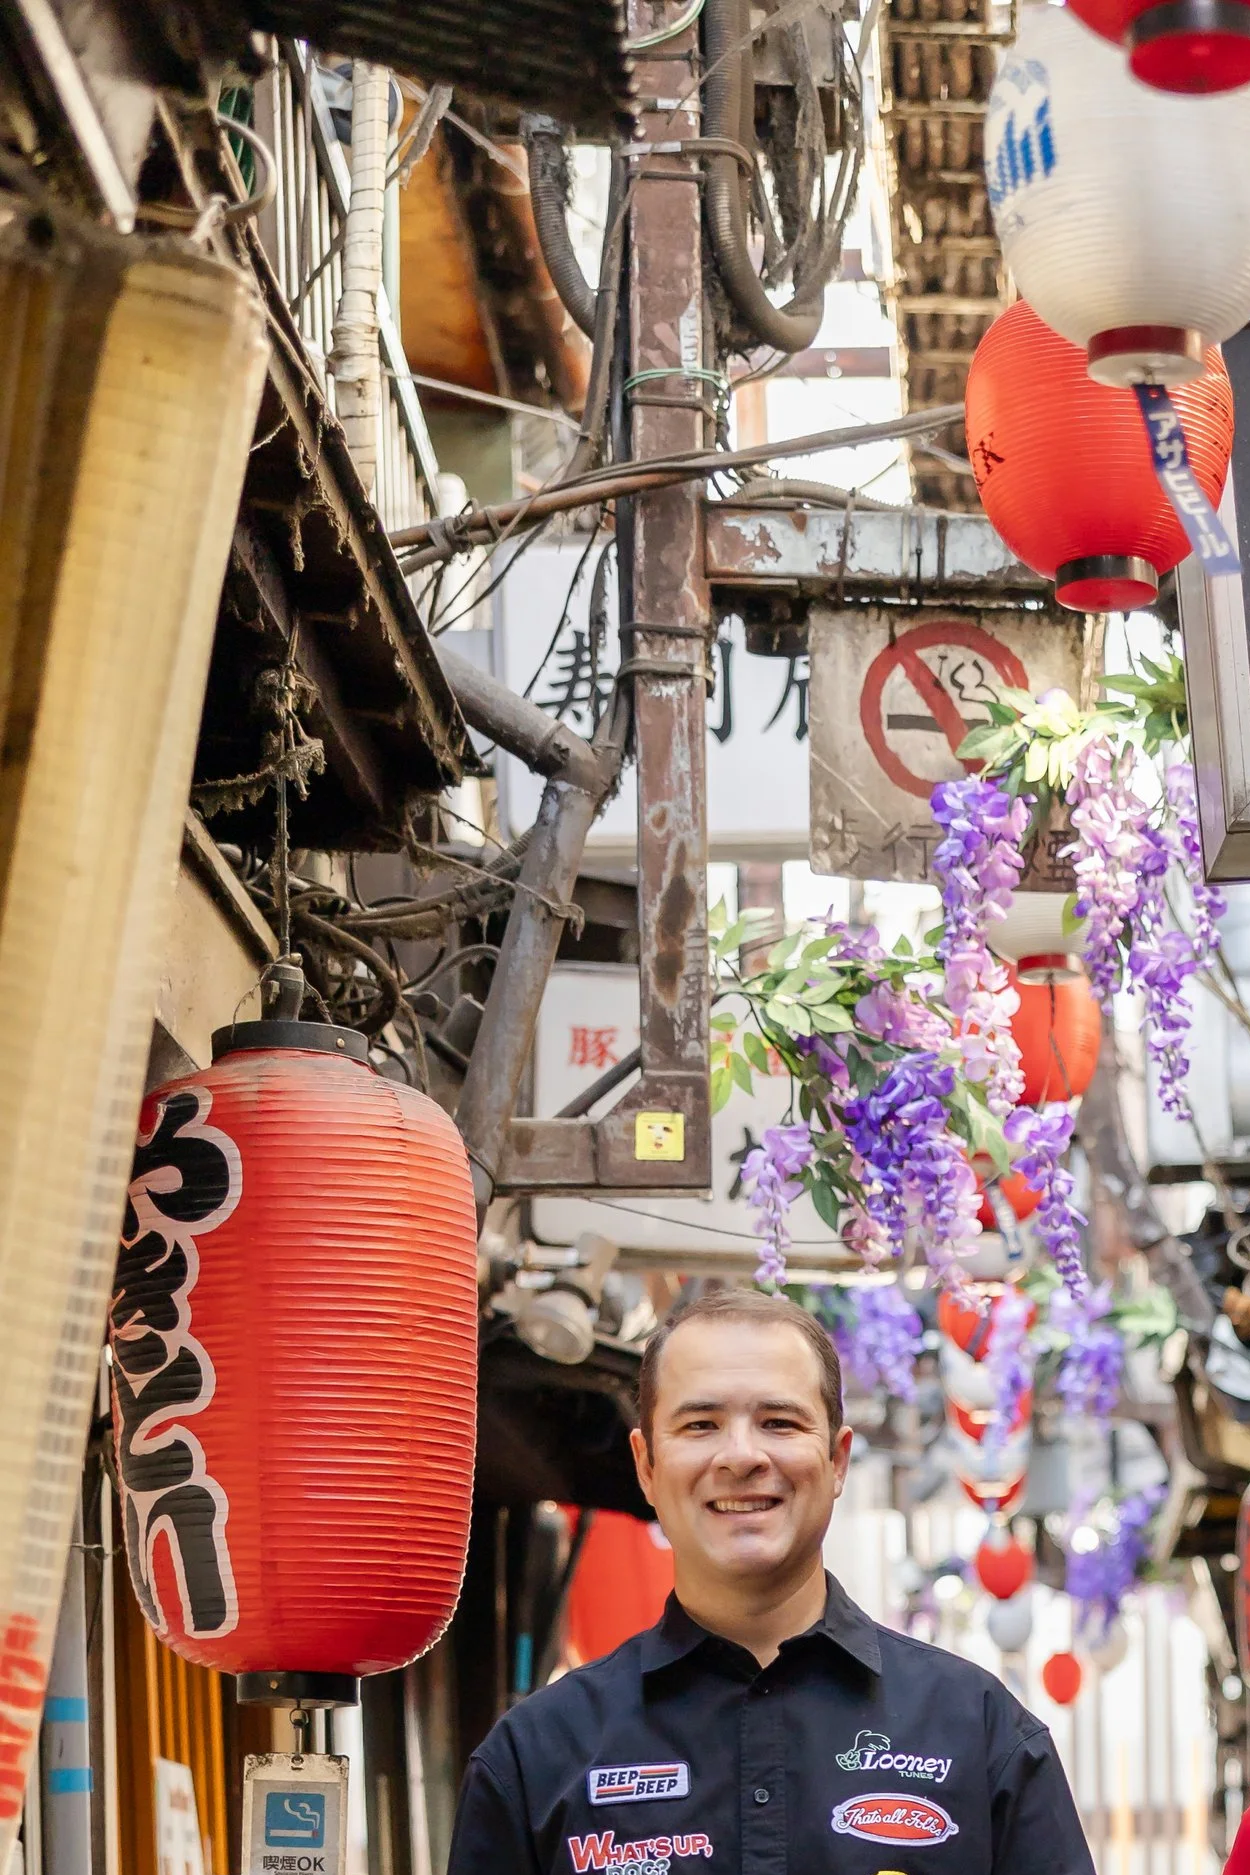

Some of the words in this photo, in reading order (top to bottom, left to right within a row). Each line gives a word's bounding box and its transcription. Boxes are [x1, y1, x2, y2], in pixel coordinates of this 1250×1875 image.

[1148, 411, 1231, 560] アサヒビール
[860, 1751, 952, 1783] Looney
[898, 1770, 934, 1780] TUNES
[597, 1771, 639, 1788] BEEP
[635, 1779, 678, 1796] BEEP
[882, 1808, 907, 1825] all
[263, 1855, 325, 1872] 喫煙OK
